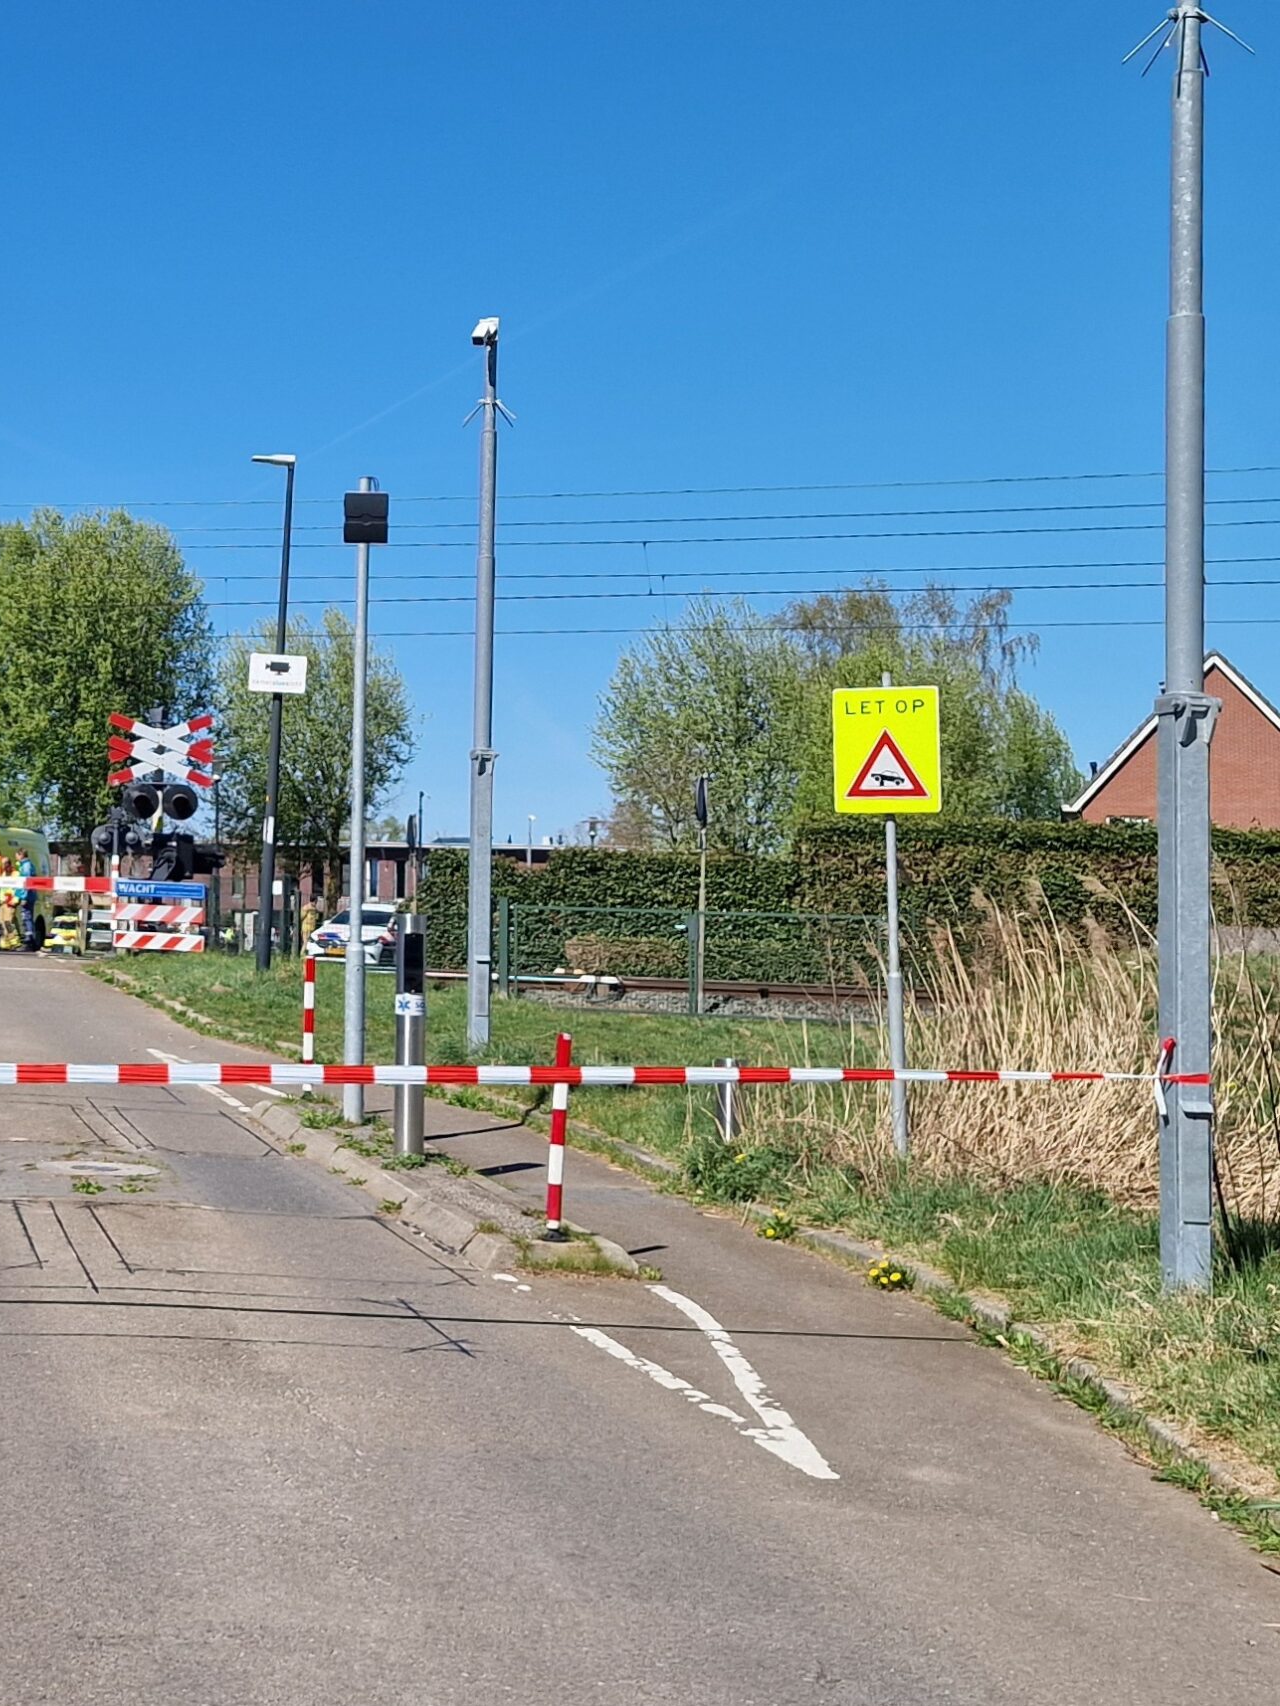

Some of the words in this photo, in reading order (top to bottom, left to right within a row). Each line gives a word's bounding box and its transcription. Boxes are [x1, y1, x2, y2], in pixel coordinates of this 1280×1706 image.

[845, 700, 885, 715] LET
[895, 699, 926, 714] OP
[118, 883, 155, 894] WACHT
